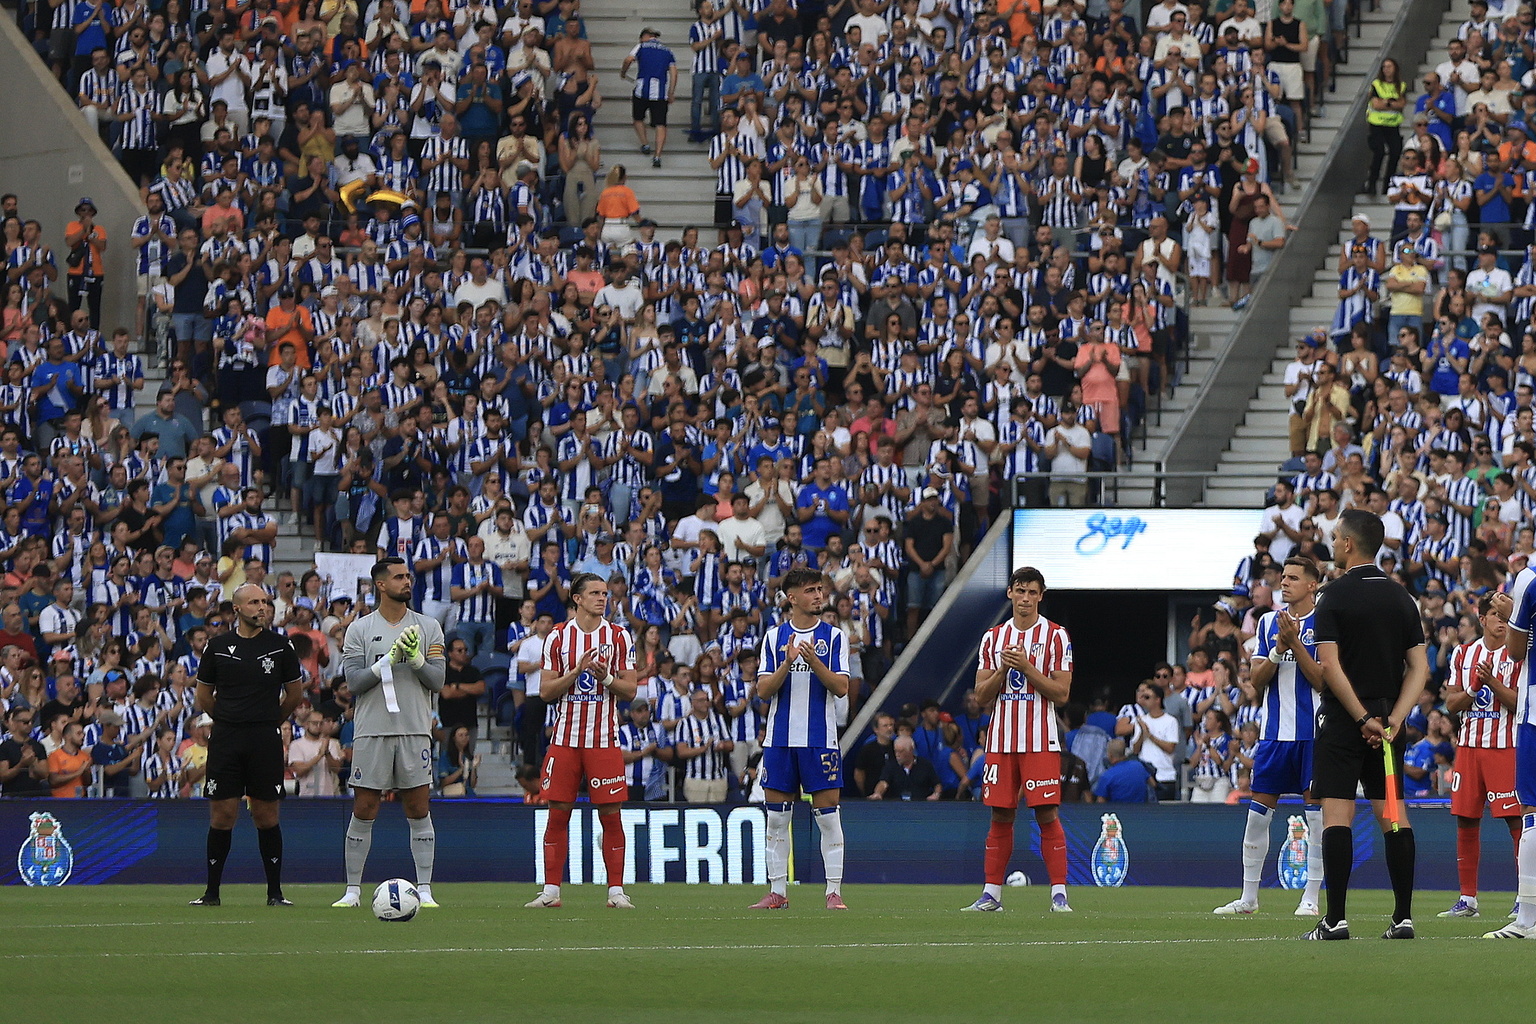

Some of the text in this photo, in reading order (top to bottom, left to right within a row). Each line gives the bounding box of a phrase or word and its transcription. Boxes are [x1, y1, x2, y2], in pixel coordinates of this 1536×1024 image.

[1000, 693, 1035, 701] RIYADH AIR
[421, 748, 433, 769] 9
[546, 757, 555, 777] 4
[983, 763, 998, 785] 24
[1452, 771, 1461, 792] 0
[1496, 790, 1516, 799] ComA
